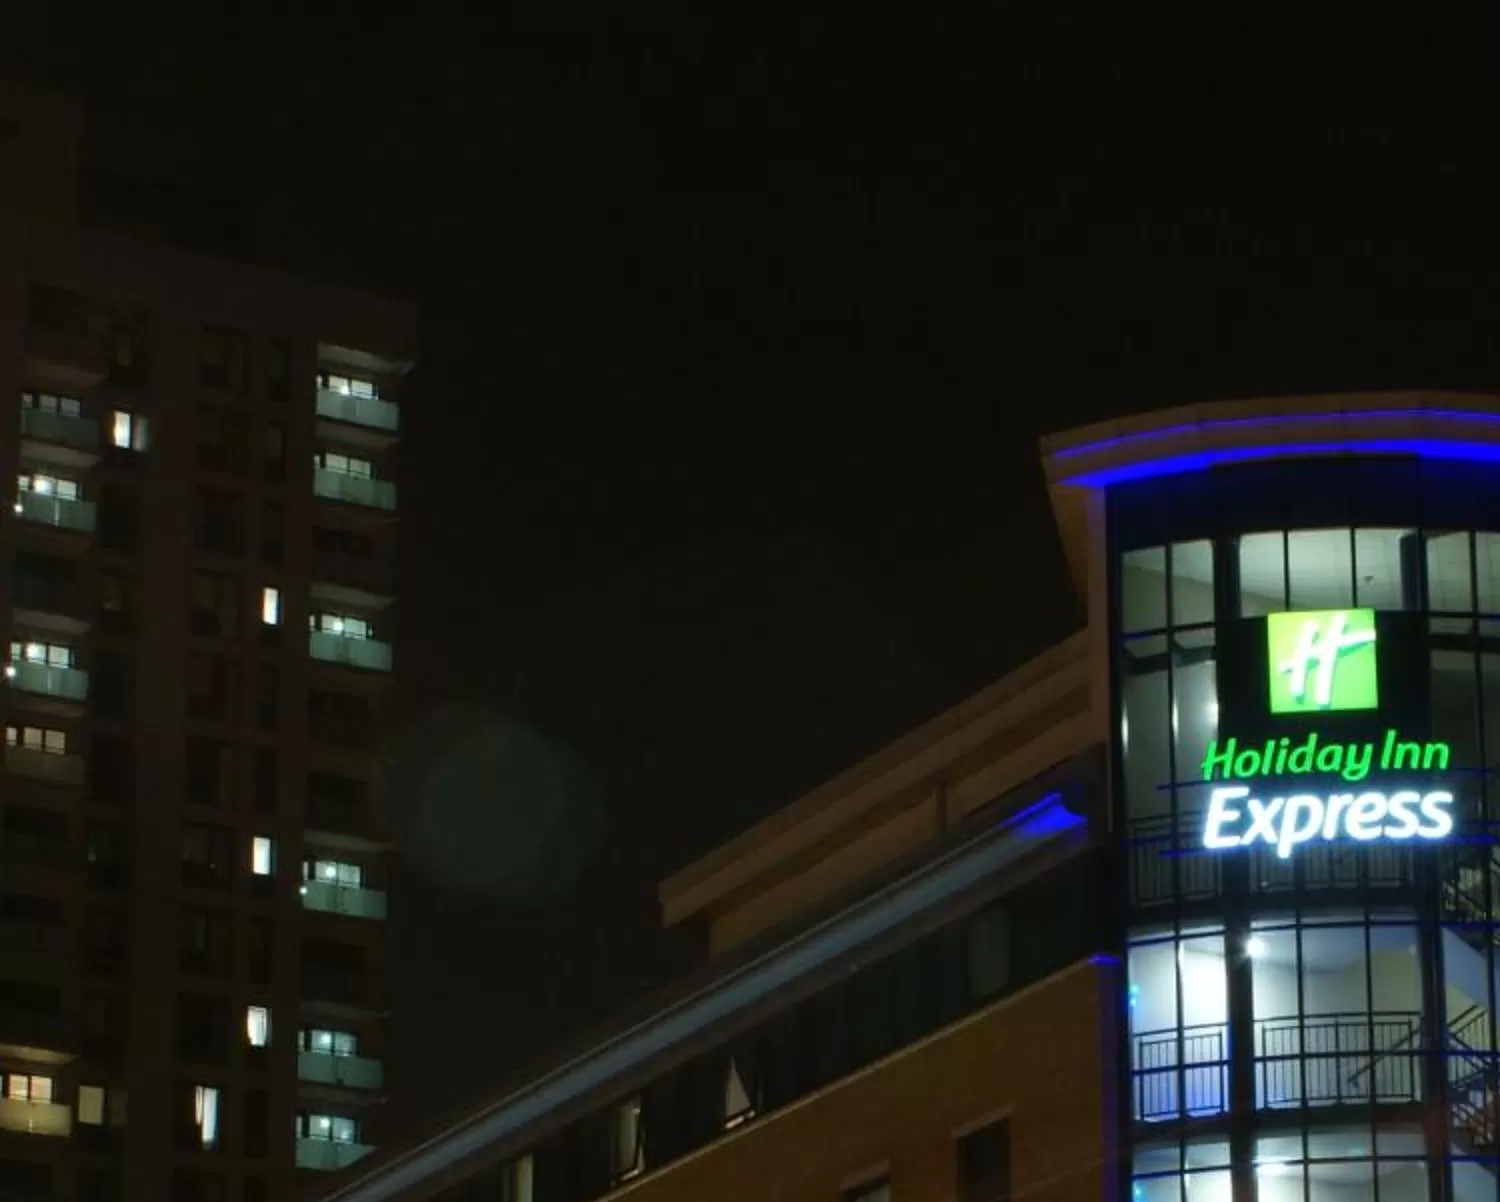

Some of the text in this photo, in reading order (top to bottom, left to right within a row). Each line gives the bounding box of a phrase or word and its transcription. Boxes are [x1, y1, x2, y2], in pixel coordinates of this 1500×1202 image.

[1201, 729, 1450, 782] Holiday Inn
[1202, 786, 1455, 860] Express
